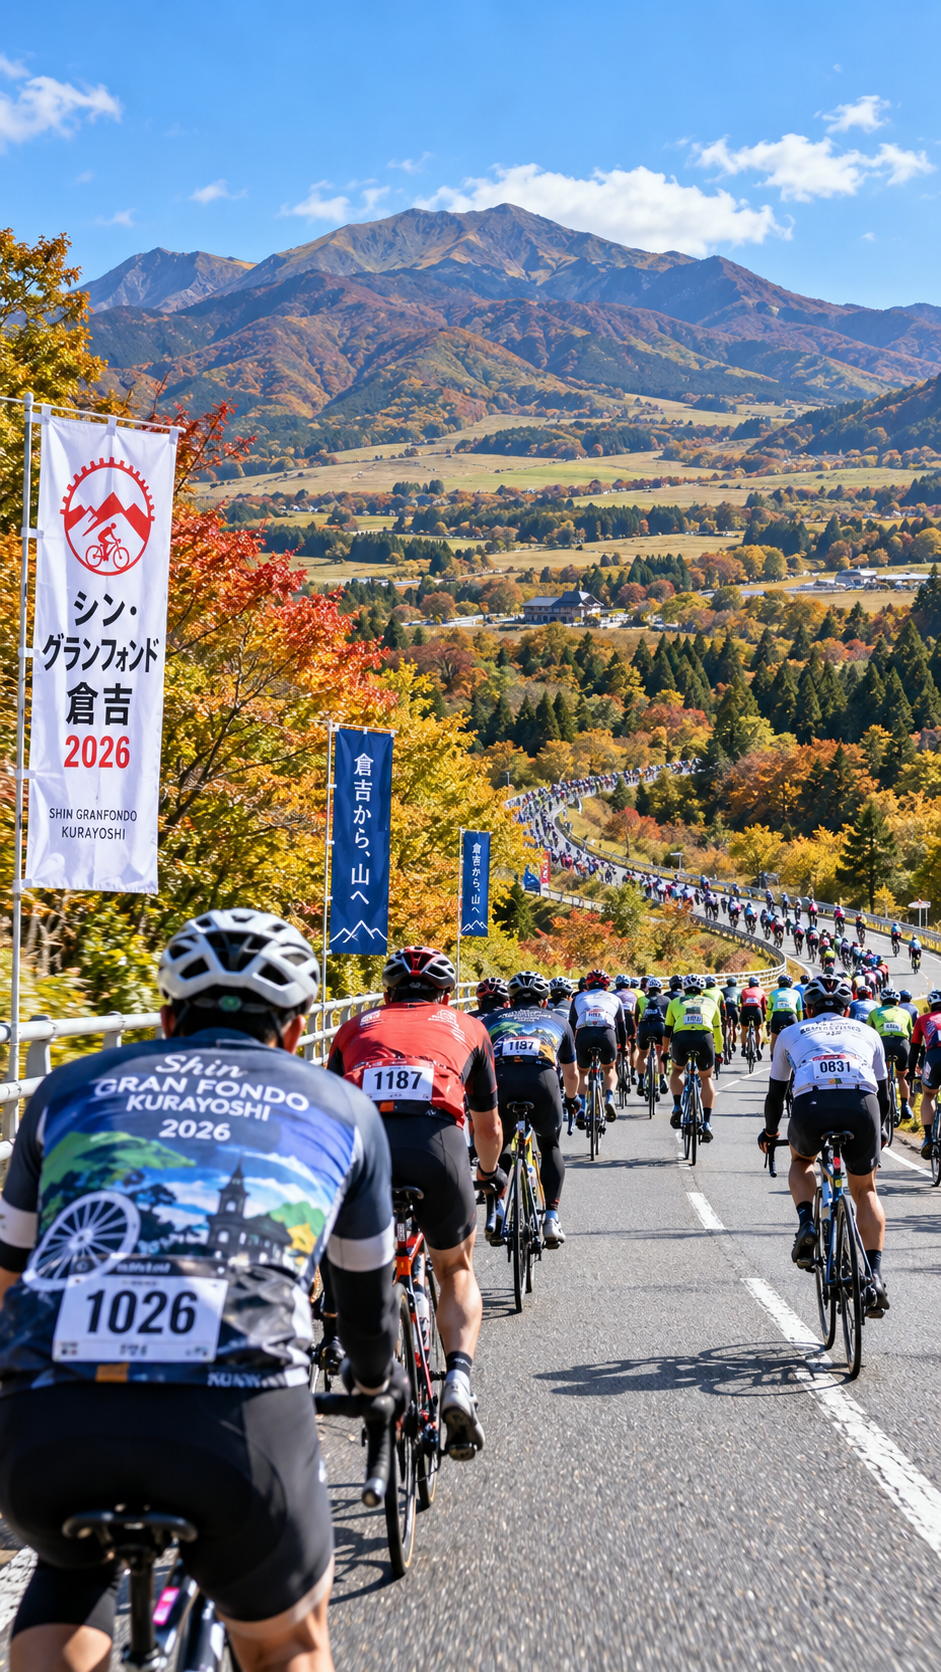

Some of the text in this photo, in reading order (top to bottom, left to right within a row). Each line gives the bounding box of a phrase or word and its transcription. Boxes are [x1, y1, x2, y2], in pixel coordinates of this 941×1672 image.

[73, 590, 137, 627] シン・
[42, 632, 160, 673] グランフォンド
[65, 682, 133, 726] 倉吉
[63, 734, 130, 769] 2026
[49, 807, 138, 822] SHIN GRANFONDO
[350, 753, 374, 905] 倉吉から、山へ
[61, 826, 126, 840] KURAYOSHI
[471, 842, 482, 914] 倉吉から、山へ
[509, 1040, 534, 1051] 1187
[155, 1054, 248, 1079] Shin
[374, 1070, 423, 1090] 1187
[820, 1060, 851, 1073] 0831
[94, 1076, 310, 1112] GRAN FONDO
[125, 1094, 271, 1122] KURAYOSHI
[158, 1118, 231, 1142] 2026
[86, 1289, 198, 1335] 1026
